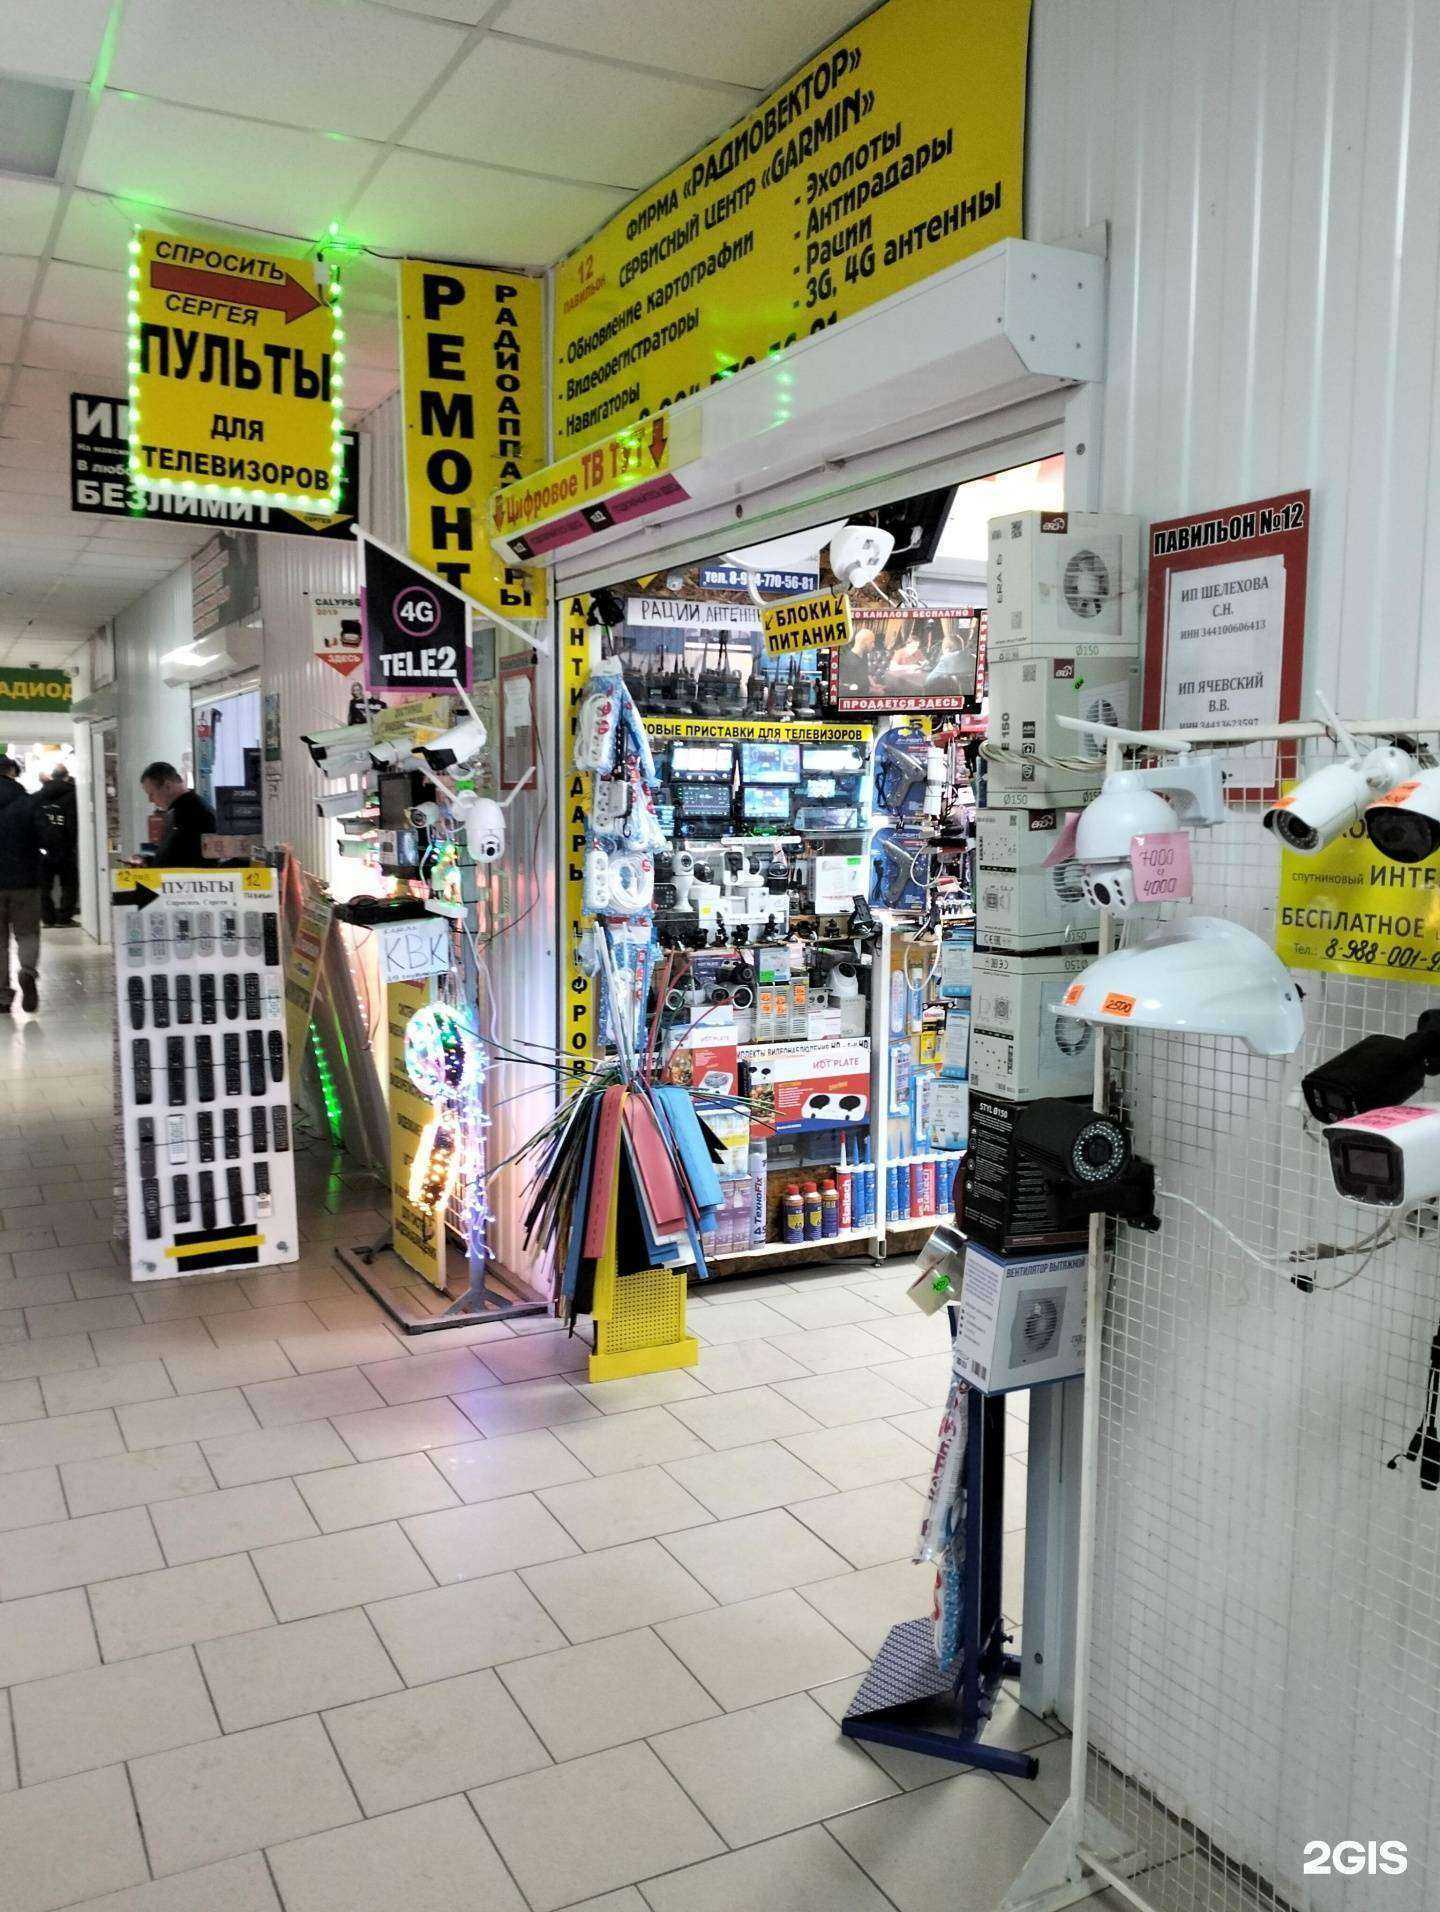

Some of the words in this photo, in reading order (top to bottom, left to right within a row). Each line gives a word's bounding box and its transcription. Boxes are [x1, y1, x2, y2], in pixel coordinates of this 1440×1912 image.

[626, 195, 679, 242] ФИРМА
[683, 45, 863, 198] «РАДИОВЕКТОР»
[806, 122, 902, 204] Эхолоты
[619, 212, 700, 289] СЕРВИСНЫЙ
[704, 178, 756, 231] ЦЕНТР
[761, 88, 875, 185] «GARMIN»
[806, 129, 953, 239] Антирадары
[806, 214, 872, 277] Рации
[845, 243, 875, 284] 4G
[882, 182, 1002, 267] антенны
[155, 241, 285, 281] СПРОСИТЬ
[577, 254, 594, 283] 12
[165, 294, 259, 326] СЕРГЕЯ
[567, 298, 643, 365] Обновление
[646, 230, 754, 320] картографии
[139, 323, 332, 402] ПУЛЬТЫ
[566, 309, 700, 401] Видеорегистраторы
[566, 382, 641, 437] Навигаторы
[211, 414, 264, 442] ДЛЯ
[420, 273, 474, 592] РЕМОНТ
[141, 445, 330, 490] ТЕЛЕВИЗОРОВ
[507, 474, 578, 526] Цифровое
[581, 449, 604, 490] ТВ
[1154, 511, 1256, 557] ПАВИЛЬОН
[1259, 501, 1305, 535] №12
[704, 571, 728, 584] тел.
[730, 572, 814, 590] 8-94-770-56-81
[1181, 587, 1198, 602] ИП
[1201, 576, 1269, 600] ШЕЛЕХОВА
[400, 601, 434, 622] 4G
[776, 601, 832, 627] БЛОКИ
[863, 610, 909, 618] КАНАЛОВ
[912, 609, 969, 618] БЕСПЛАТНО
[1213, 603, 1234, 617] С.Н.
[769, 622, 847, 651] ПИТАНИЯ
[1180, 629, 1199, 640] ИНН
[379, 646, 457, 677] TELE2
[1178, 681, 1195, 696] ИП
[1199, 672, 1264, 693] ЯЧЕВСКИЙ
[843, 699, 916, 709] ПРОДАЕТСЯ
[919, 699, 959, 708] ЗДЕСЬ
[1208, 699, 1230, 712] В.В.
[686, 725, 755, 738] ПРИСТАВКИ
[758, 728, 781, 740] ДЛЯ
[785, 729, 862, 740] ТЕЛЕВИЗОРОВ
[1139, 849, 1174, 866] 7000
[162, 880, 234, 893] ПУЛЬТЫ
[247, 872, 261, 887] 12
[1143, 878, 1177, 896] 4000
[1292, 872, 1364, 886] спутниковый
[1282, 907, 1425, 938] БЕСПЛАТНОЕ
[385, 933, 447, 973] КВК
[833, 1057, 860, 1067] PLATE
[1006, 1263, 1048, 1278] ВЕНТИЛЯТОР
